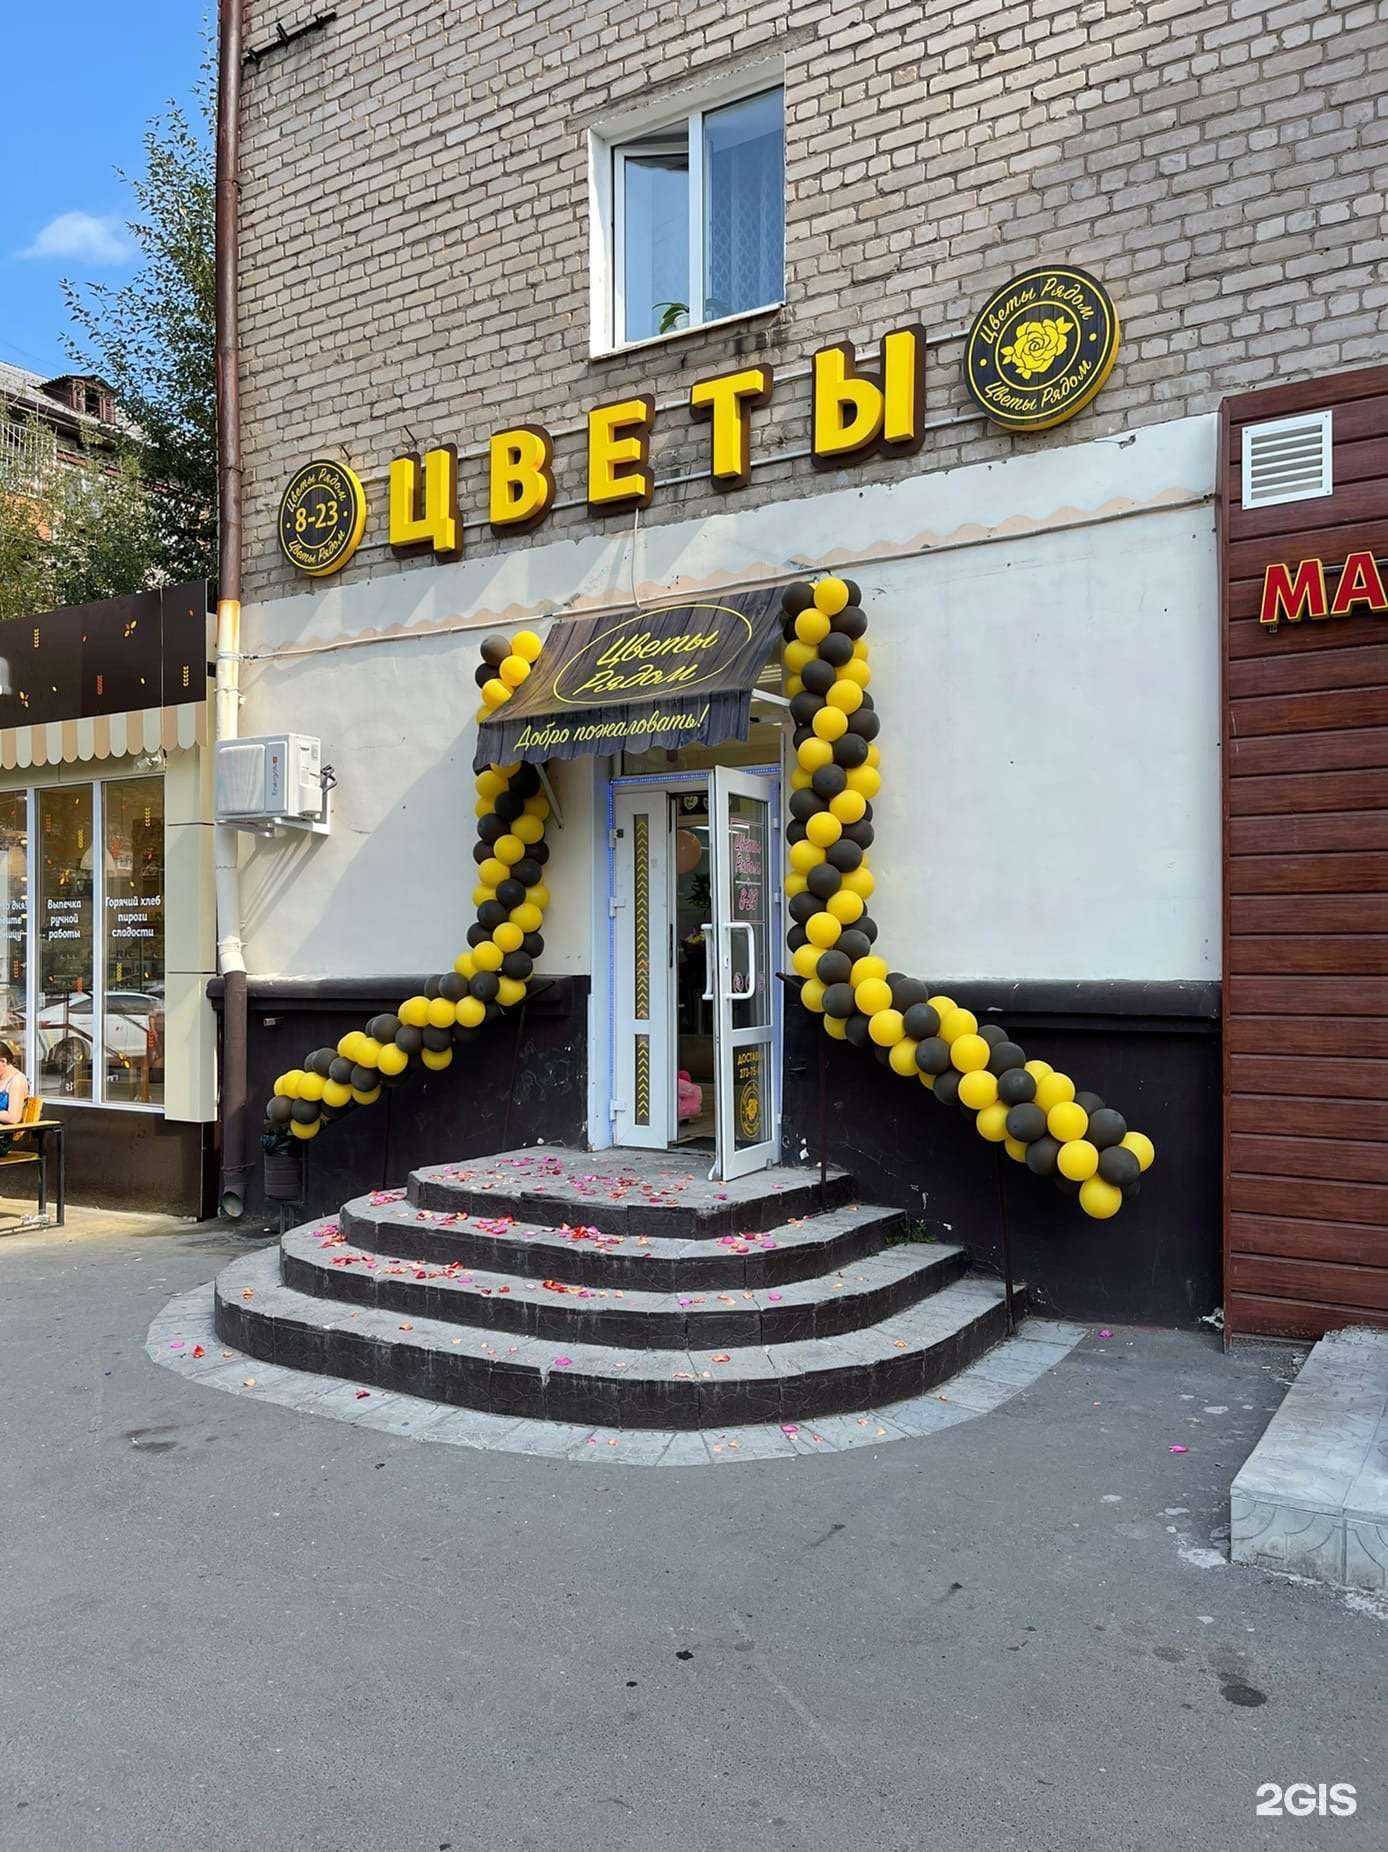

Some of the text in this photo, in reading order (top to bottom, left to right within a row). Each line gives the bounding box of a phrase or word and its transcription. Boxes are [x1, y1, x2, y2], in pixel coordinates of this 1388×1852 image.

[980, 277, 1095, 344] Цветы Рядом
[985, 359, 1091, 411] Цветы Рядом
[388, 329, 917, 553] ЦВЕТЫ
[287, 468, 346, 512] Цветы Рядом
[295, 500, 338, 532] 8-23
[288, 530, 345, 564] Цветы Рядом
[1260, 551, 1388, 623] МА
[597, 630, 719, 669] Цветы
[572, 663, 698, 696] Рядом
[513, 704, 710, 752] Добро пожаловать!
[47, 899, 82, 910] Выпечка
[105, 895, 161, 910] Горячий хлеб
[117, 913, 148, 925] пироги
[48, 928, 81, 942] работы
[50, 913, 79, 927] ручной
[111, 926, 154, 938] сладости
